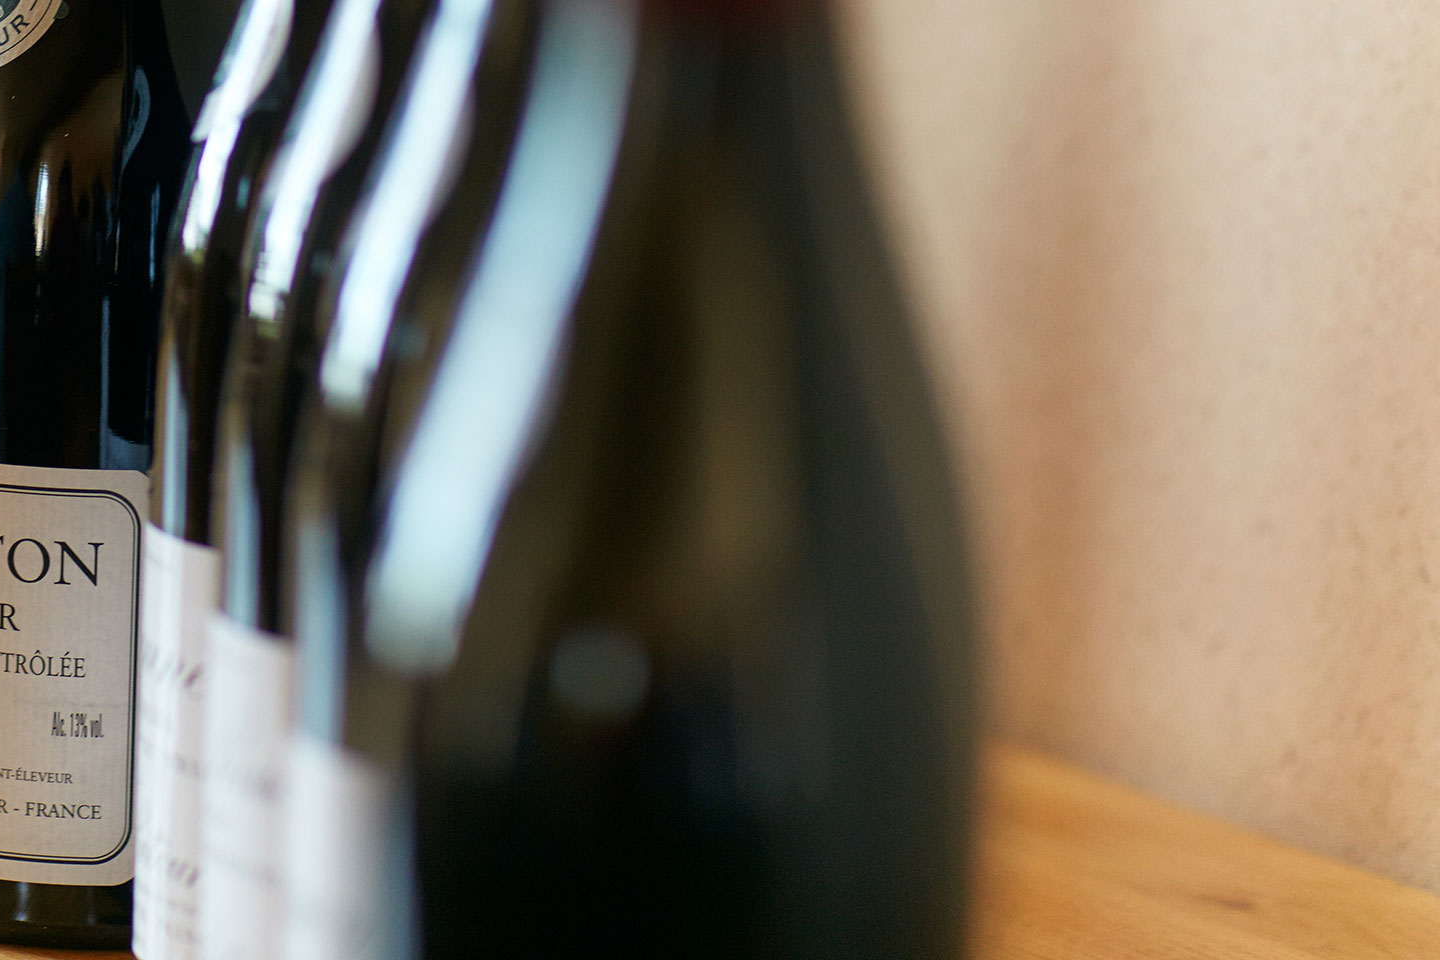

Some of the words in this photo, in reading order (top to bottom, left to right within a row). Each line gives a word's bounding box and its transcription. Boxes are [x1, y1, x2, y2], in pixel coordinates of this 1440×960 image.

[51, 711, 67, 737] Alc.
[70, 713, 88, 738] 13%
[90, 713, 105, 738] vol.
[25, 801, 102, 820] FRANCE
